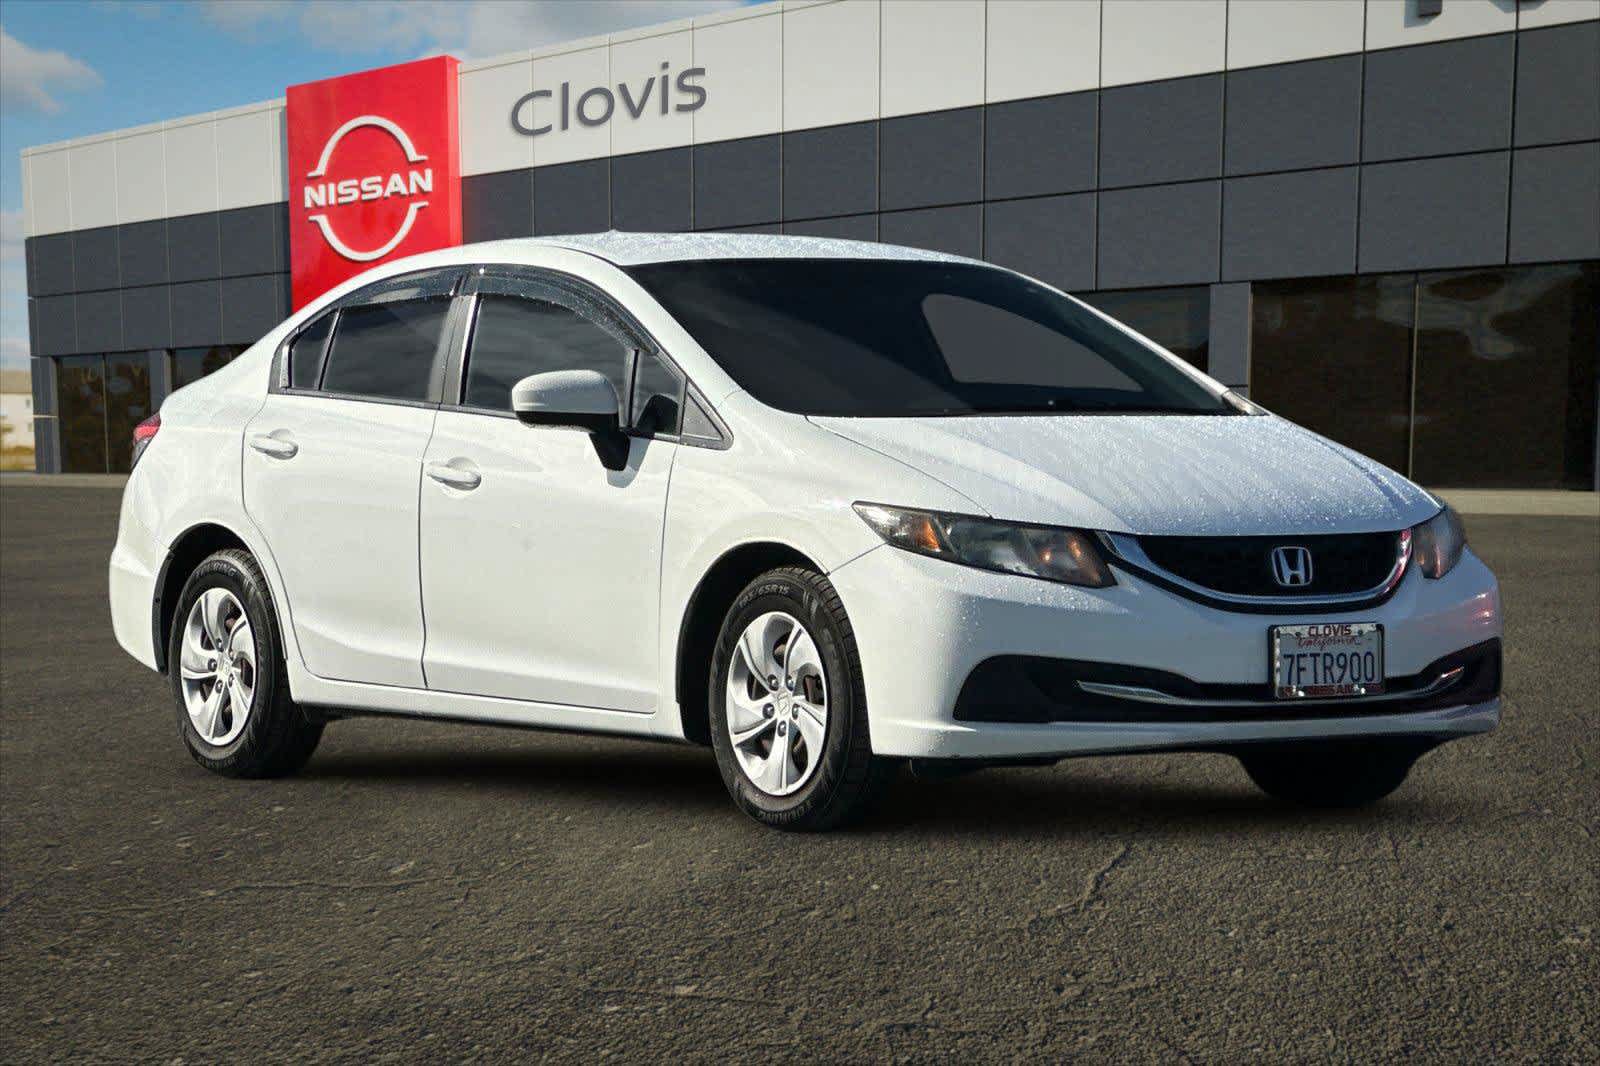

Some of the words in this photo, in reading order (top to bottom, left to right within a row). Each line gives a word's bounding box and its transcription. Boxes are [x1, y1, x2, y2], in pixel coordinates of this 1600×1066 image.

[510, 61, 707, 136] Clovis
[304, 168, 433, 208] NISSAN
[1308, 624, 1352, 637] CLOVIS
[1283, 651, 1375, 685] 7FTR900
